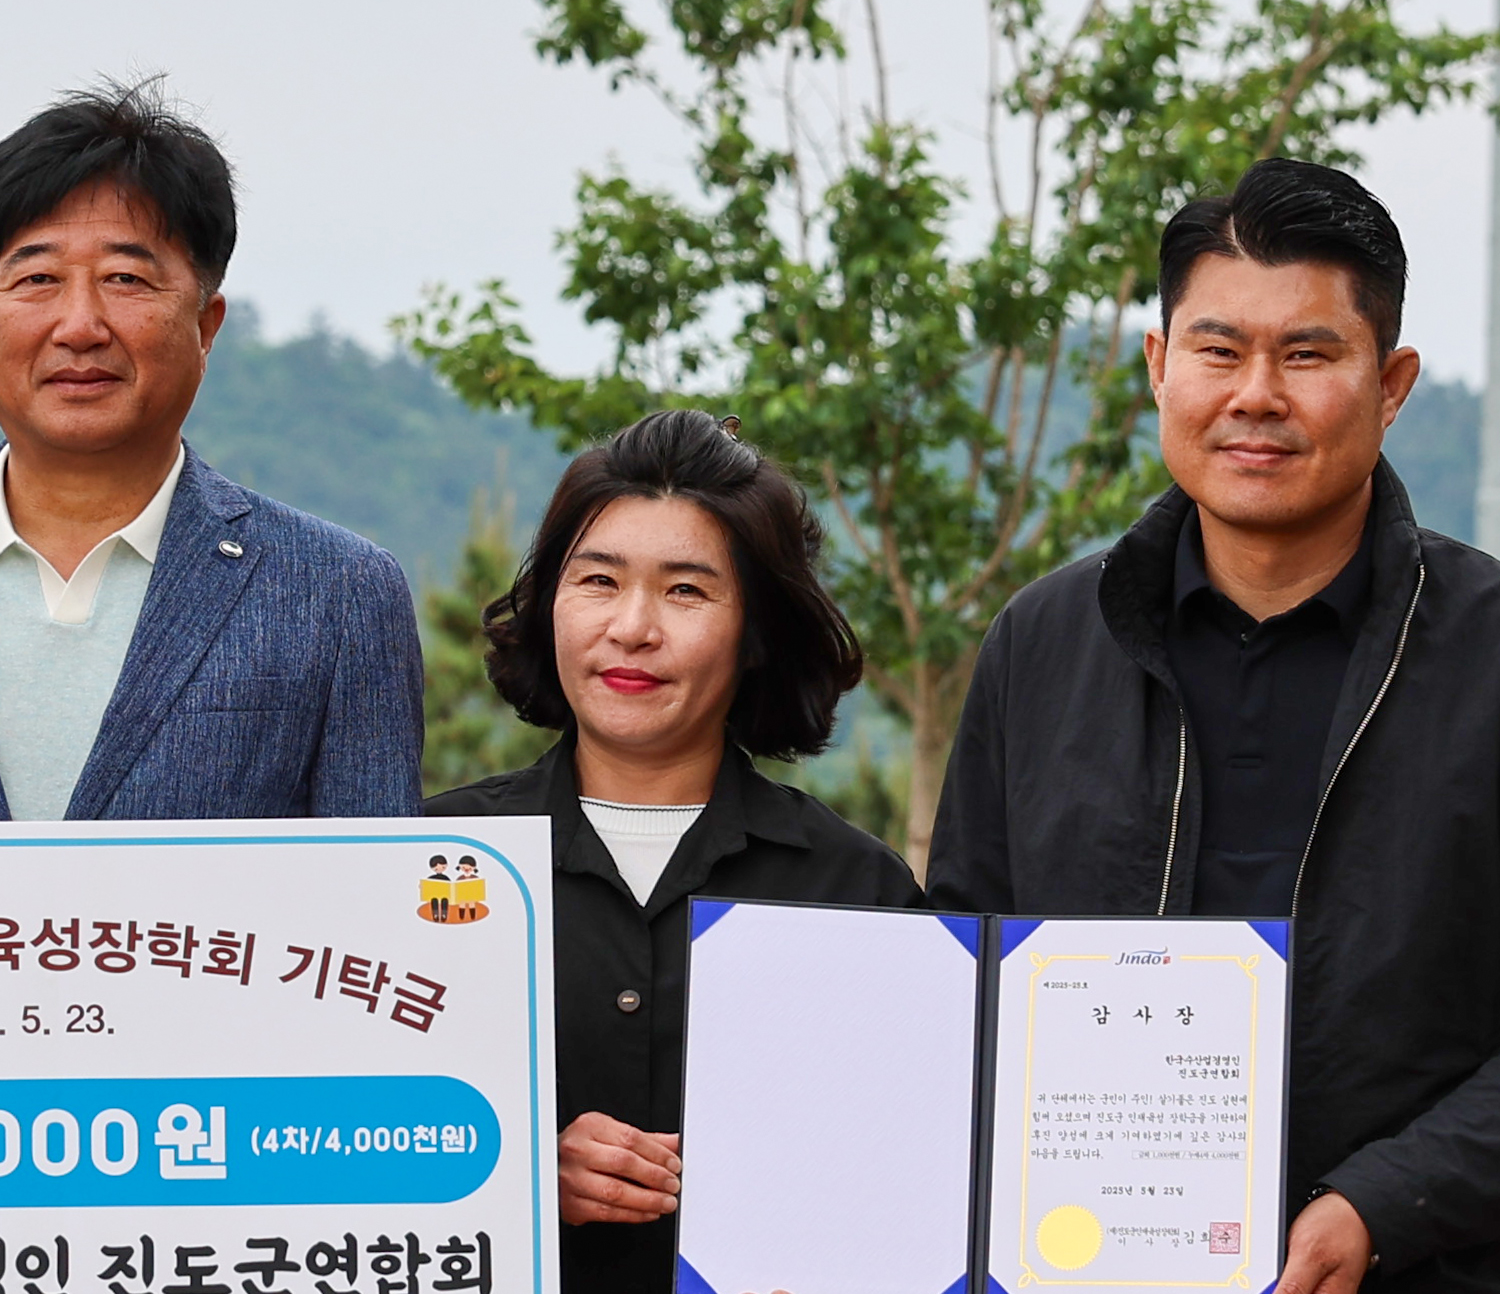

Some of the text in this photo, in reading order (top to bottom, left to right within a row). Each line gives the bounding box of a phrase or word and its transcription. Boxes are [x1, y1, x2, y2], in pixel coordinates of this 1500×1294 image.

[1115, 952, 1161, 965] Jindo
[279, 943, 448, 1034] 기탁금
[20, 1003, 52, 1036] 5.
[65, 1003, 116, 1036] 23.
[1166, 1055, 1240, 1066] 한국수산업경영인
[1178, 1069, 1240, 1079] 진도군연합회
[1199, 1094, 1217, 1105] 진도
[1097, 1113, 1123, 1124] 진도군
[1128, 1113, 1164, 1124] 인재육성
[1170, 1113, 1206, 1124] 장학금을
[251, 1124, 477, 1157] (4차/4,000천원)
[1031, 1149, 1058, 1160] 마음을
[1101, 1186, 1183, 1196] 2025년 5월 23일
